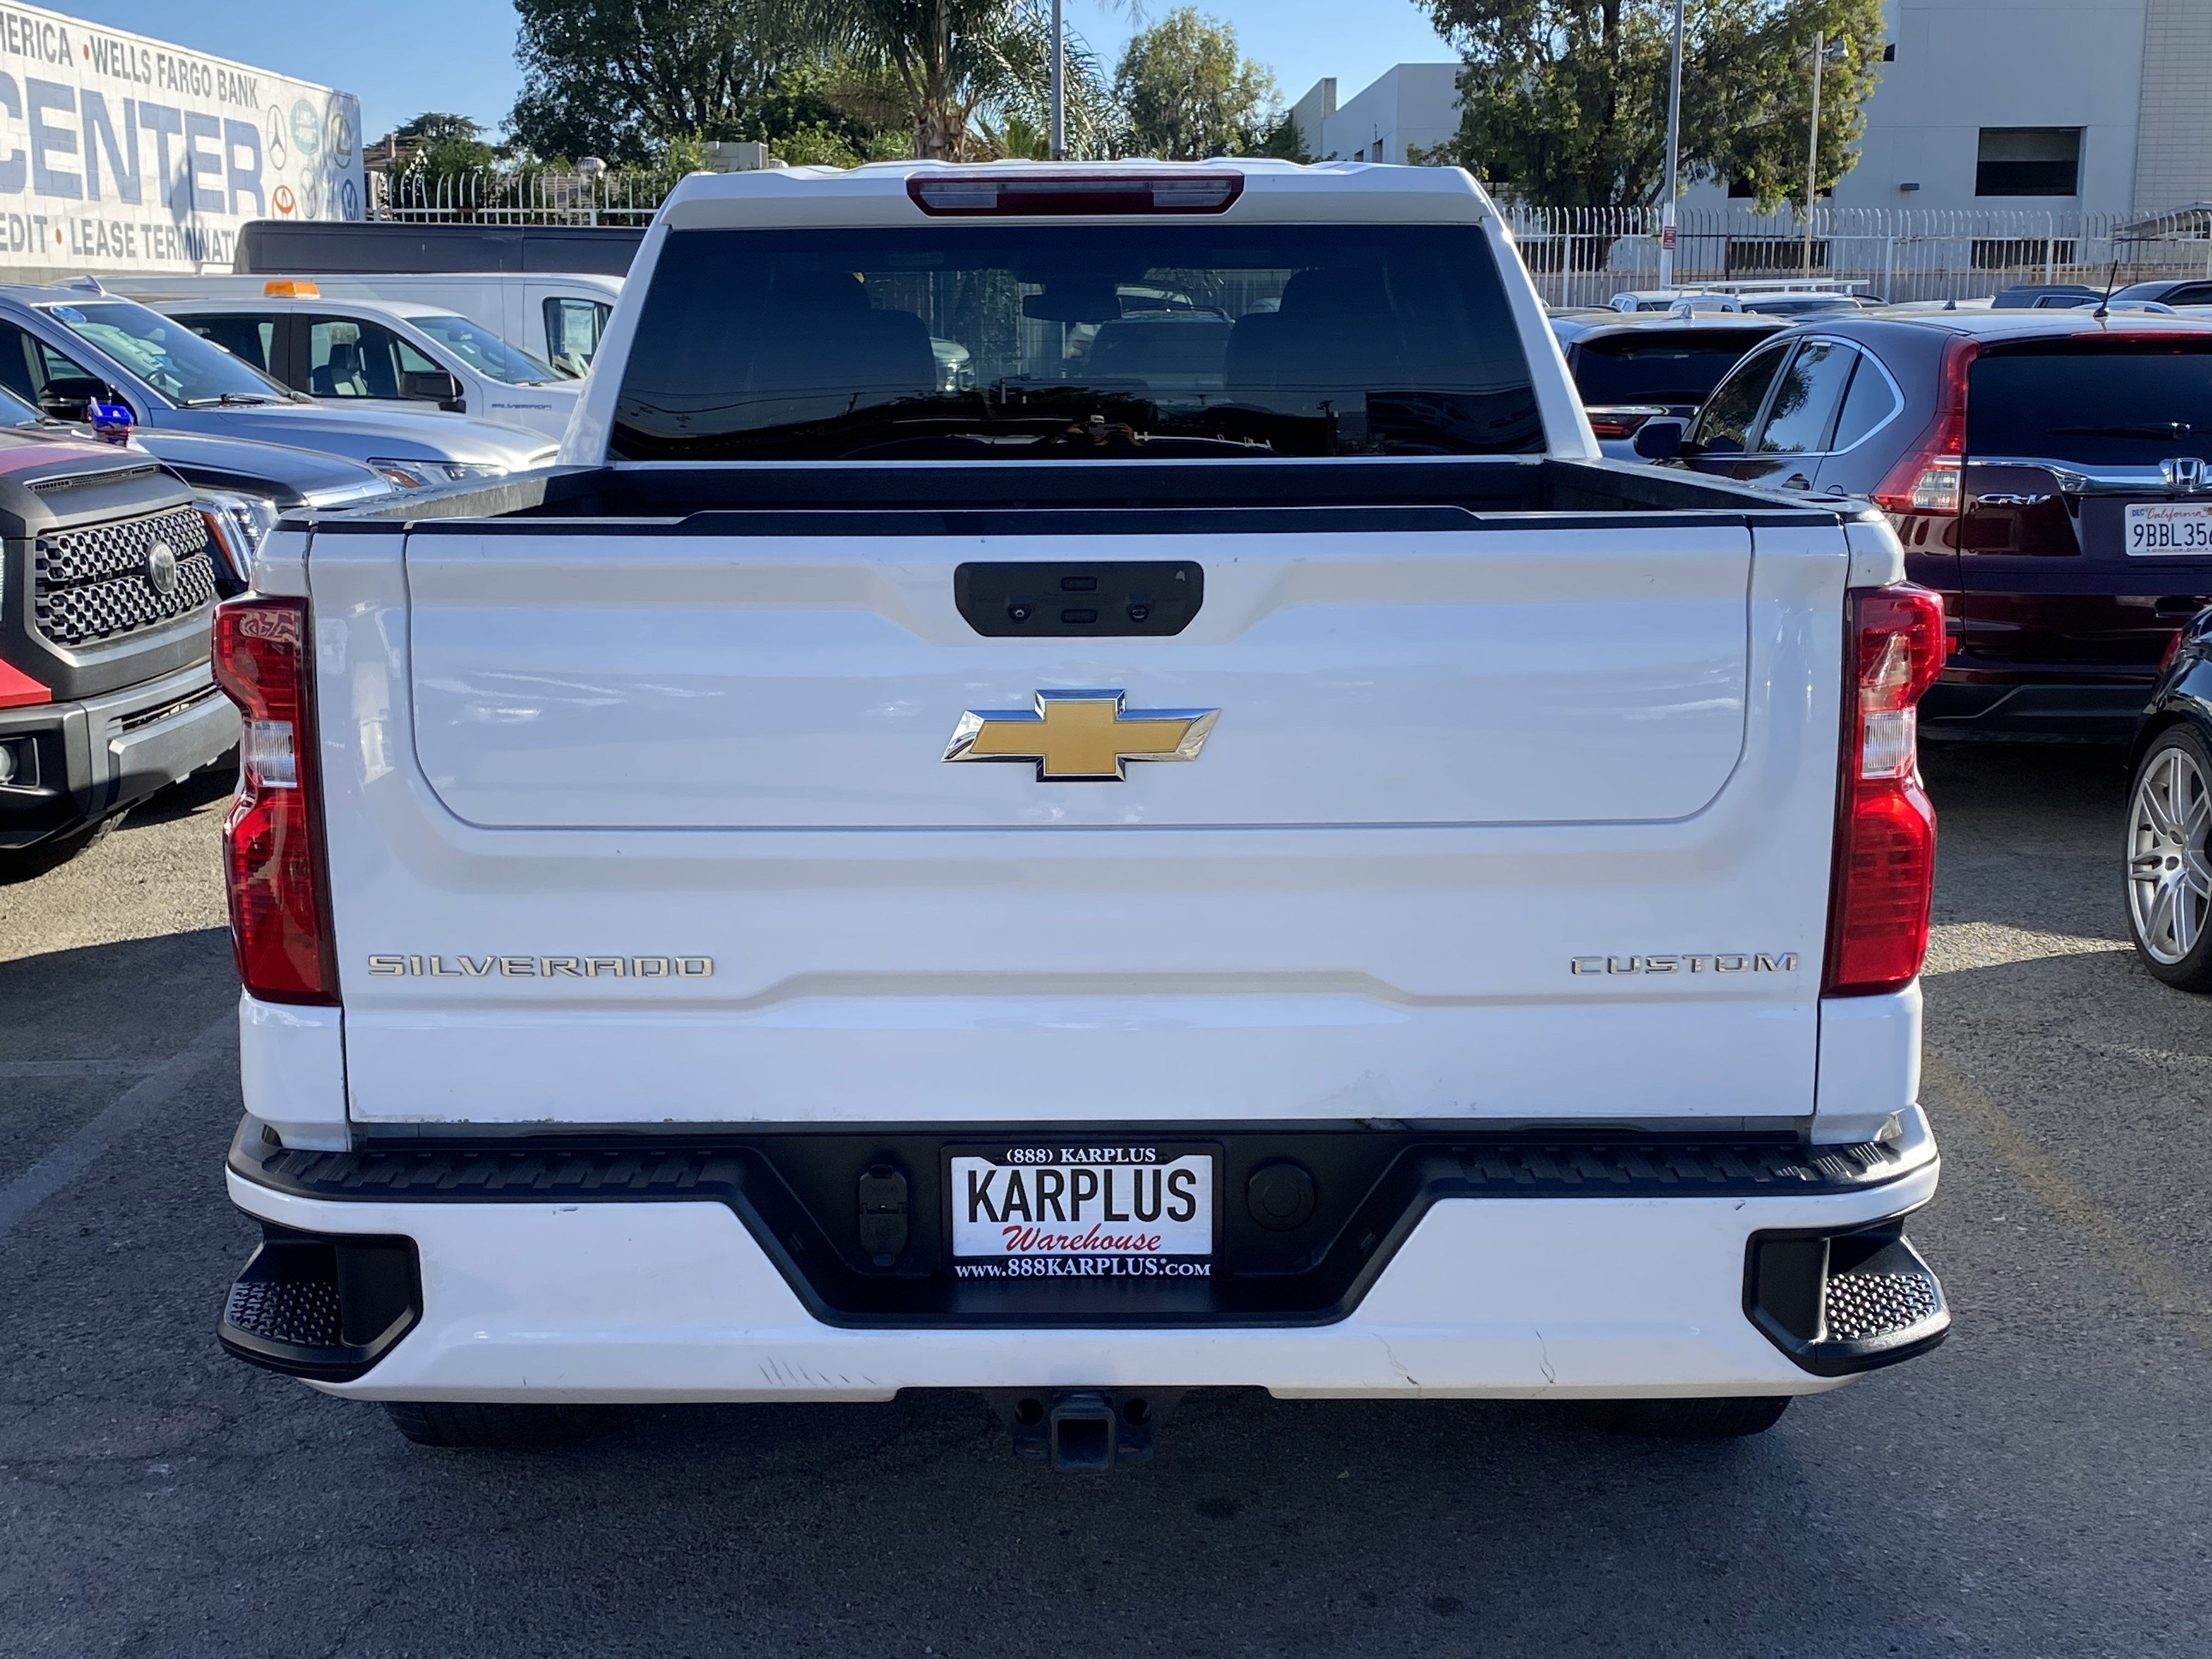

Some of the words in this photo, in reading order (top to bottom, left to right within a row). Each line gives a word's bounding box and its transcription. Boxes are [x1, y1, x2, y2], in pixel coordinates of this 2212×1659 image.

[89, 35, 151, 84] WELLS
[157, 53, 212, 98] FARGO
[217, 69, 259, 109] BANK
[70, 218, 136, 258] LEASE
[2147, 507, 2208, 522] California
[368, 955, 714, 978] SILVERADO
[1571, 952, 1798, 975] CUSTOM
[1007, 1148, 1053, 1164] (888)
[1060, 1148, 1156, 1163] KARPLUS
[968, 1169, 1197, 1223] KARPLUS
[1002, 1223, 1161, 1252] Warehouse
